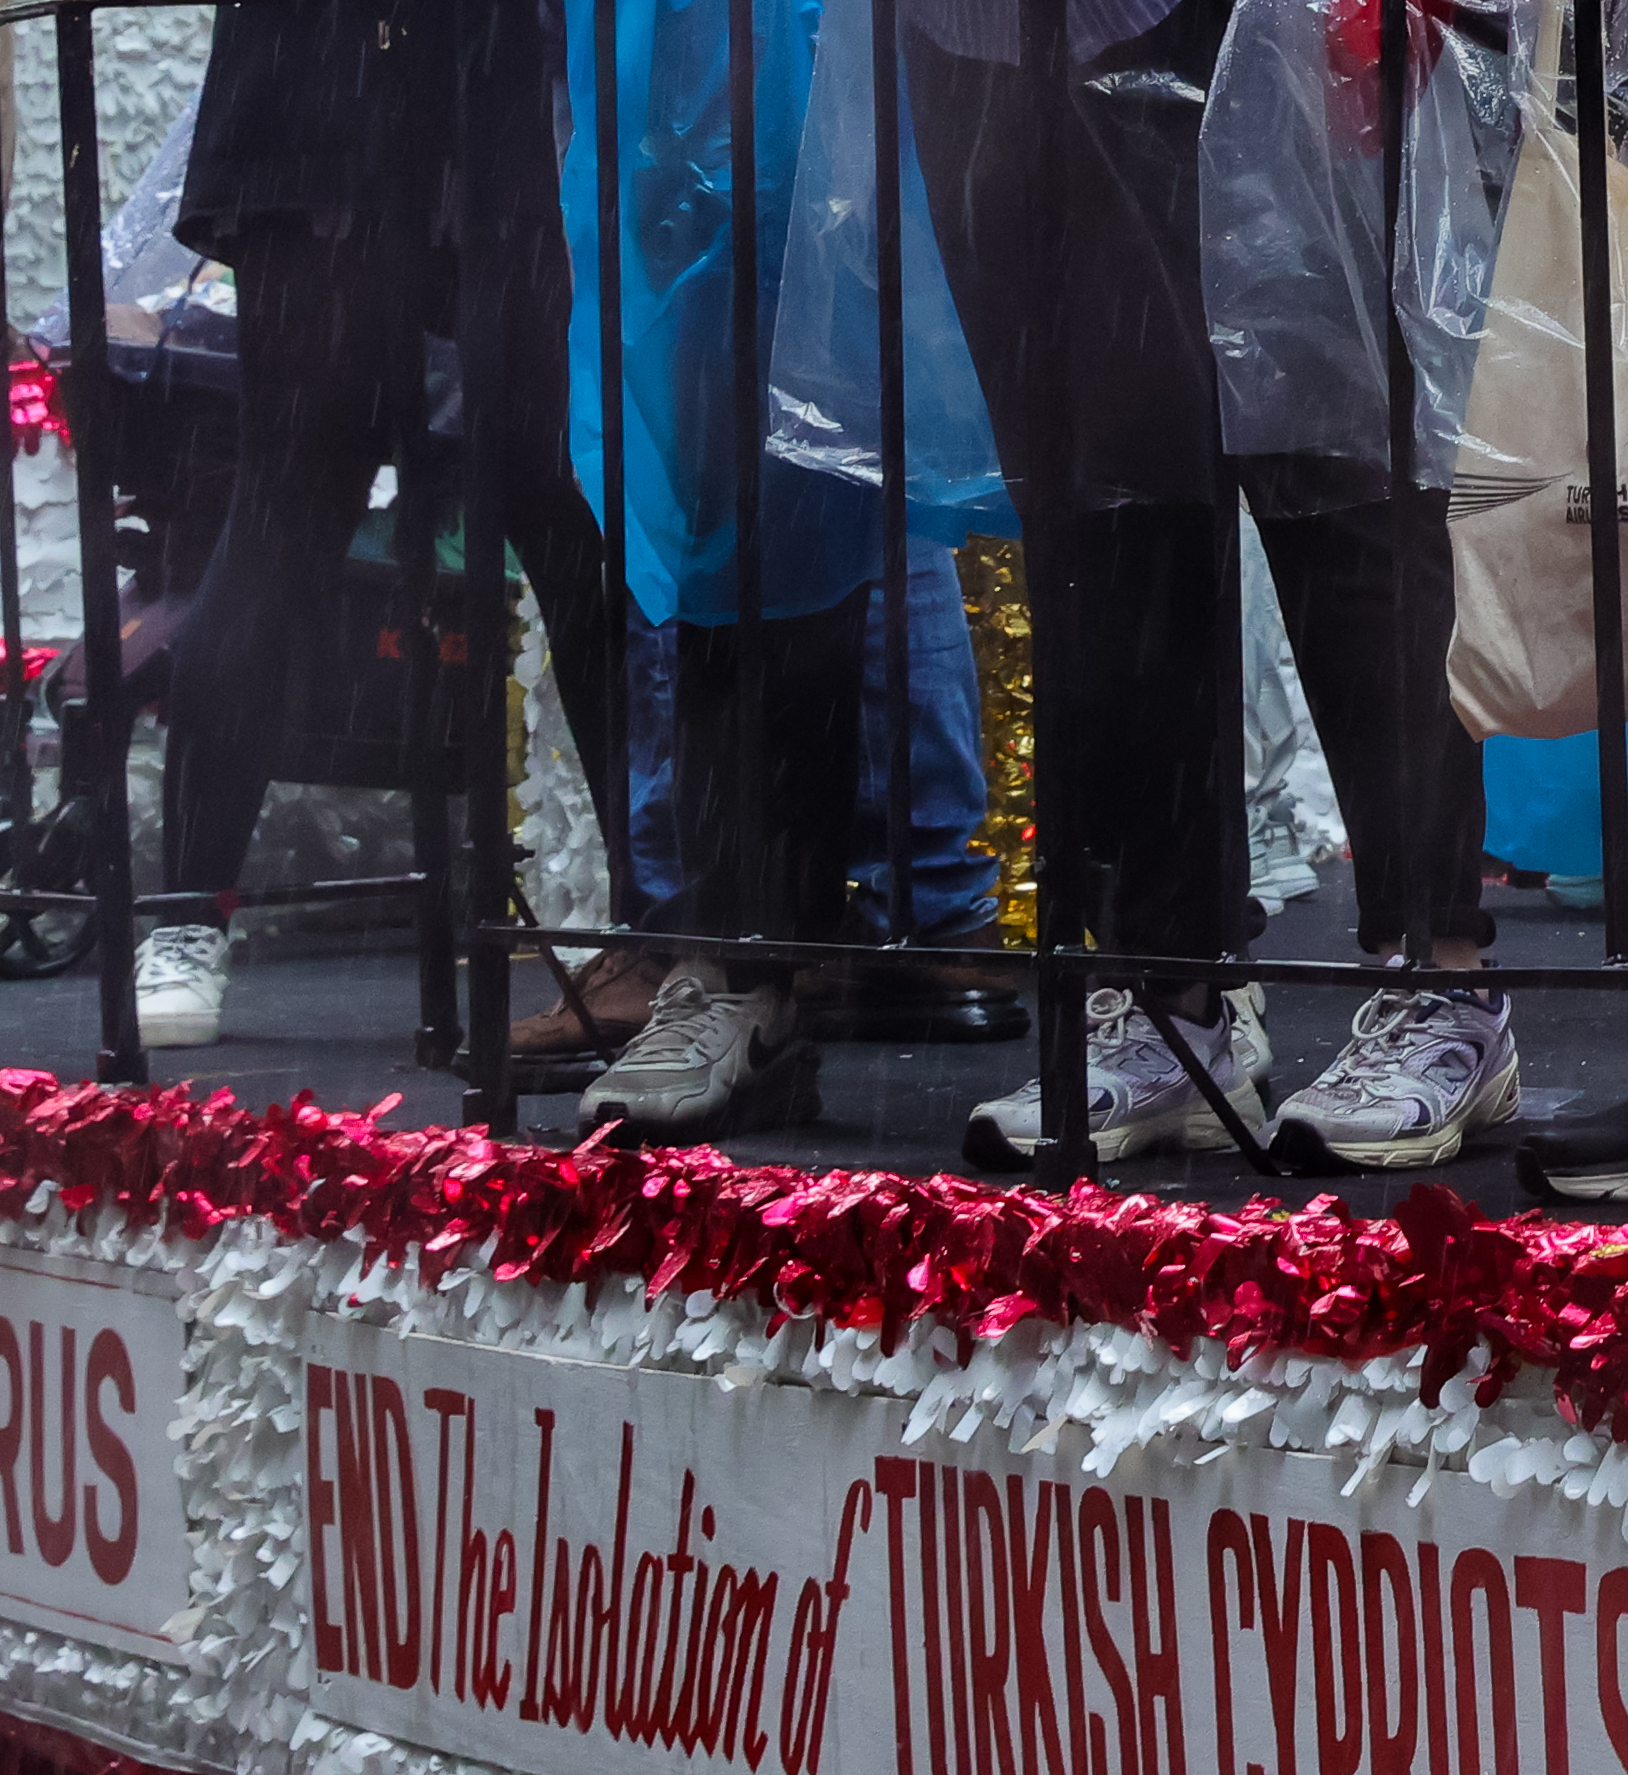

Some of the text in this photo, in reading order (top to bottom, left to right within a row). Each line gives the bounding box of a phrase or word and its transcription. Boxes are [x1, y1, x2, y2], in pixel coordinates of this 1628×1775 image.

[1566, 483, 1628, 505] TURH
[0, 1317, 138, 1586] RUS
[306, 1363, 422, 1691] END
[424, 1387, 518, 1711] The
[520, 1408, 779, 1774] Isolation
[780, 1478, 873, 1775] of
[874, 1456, 1188, 1775] TURKISH
